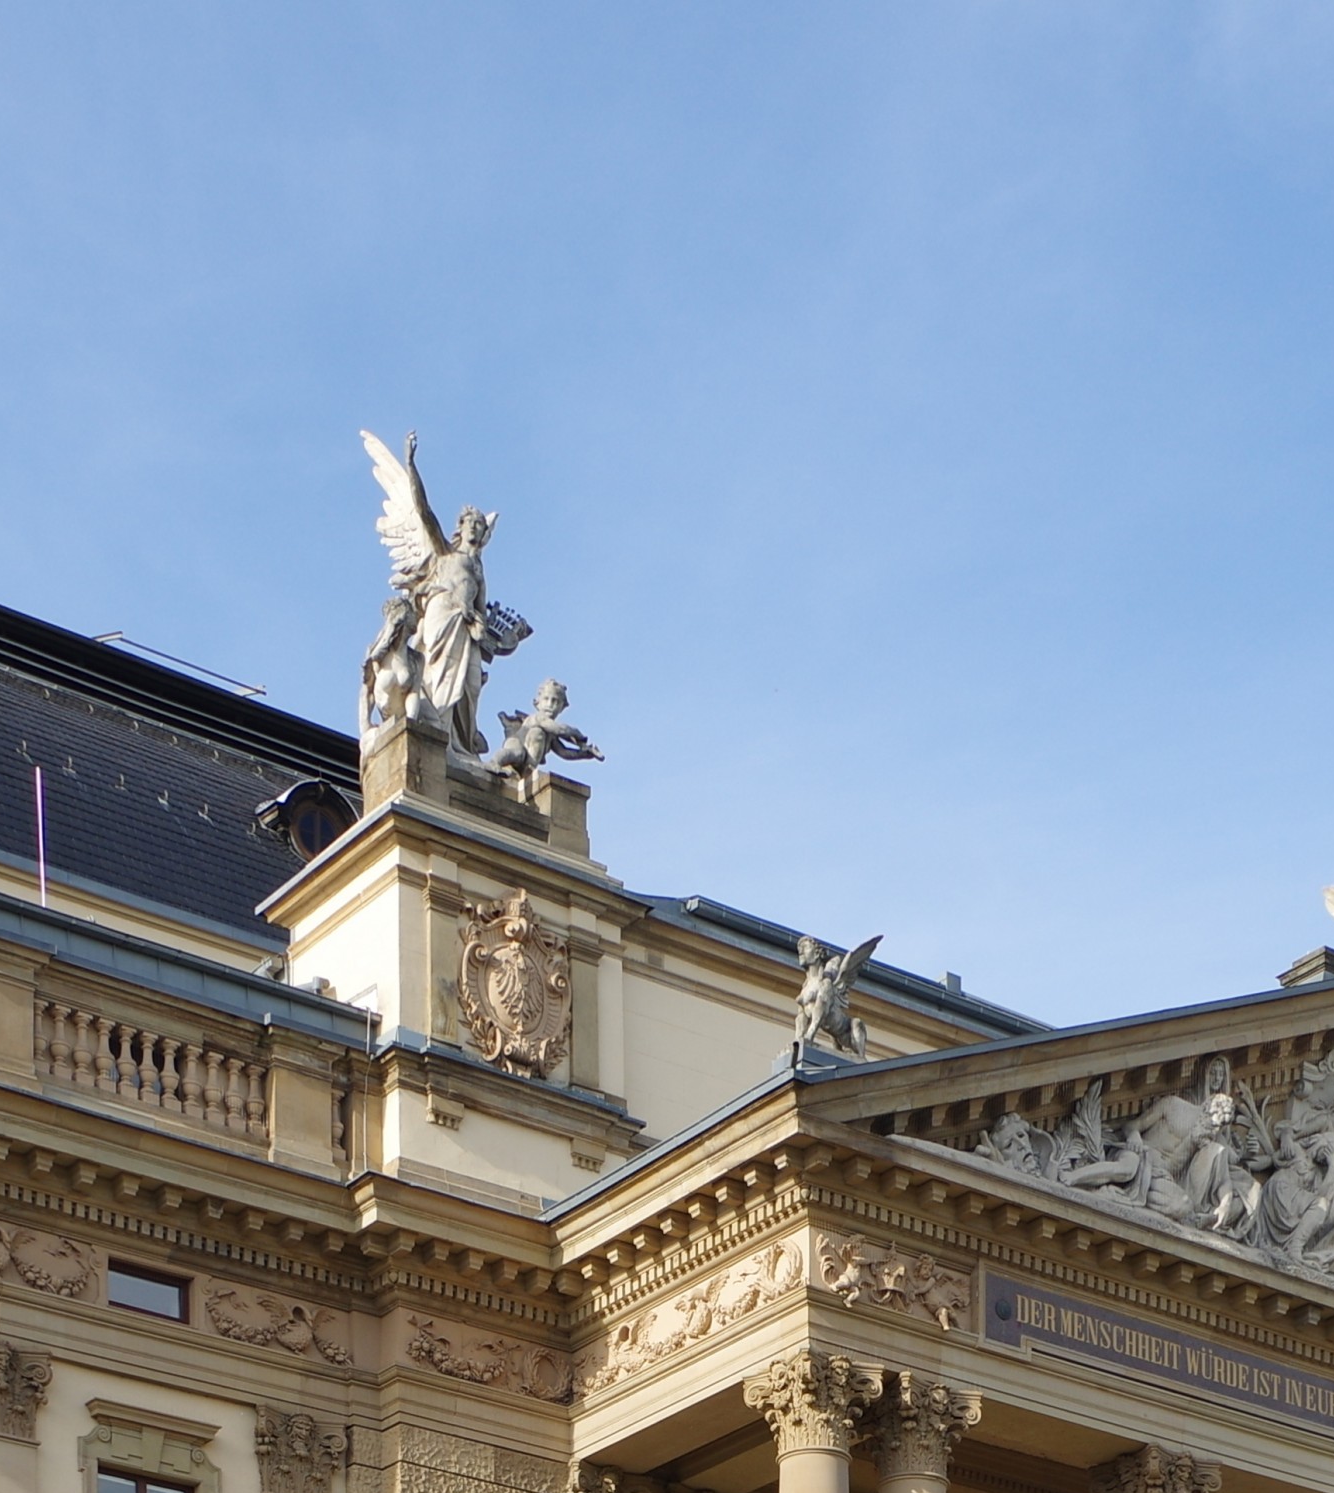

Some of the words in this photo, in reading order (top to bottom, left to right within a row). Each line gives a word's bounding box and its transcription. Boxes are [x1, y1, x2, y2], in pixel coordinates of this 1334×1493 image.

[1016, 1294, 1057, 1333] DER
[1060, 1308, 1181, 1370] MENSCHHEIT
[1186, 1347, 1250, 1392] WÜRDE
[1253, 1368, 1281, 1400] IST
[1285, 1378, 1303, 1408] IN
